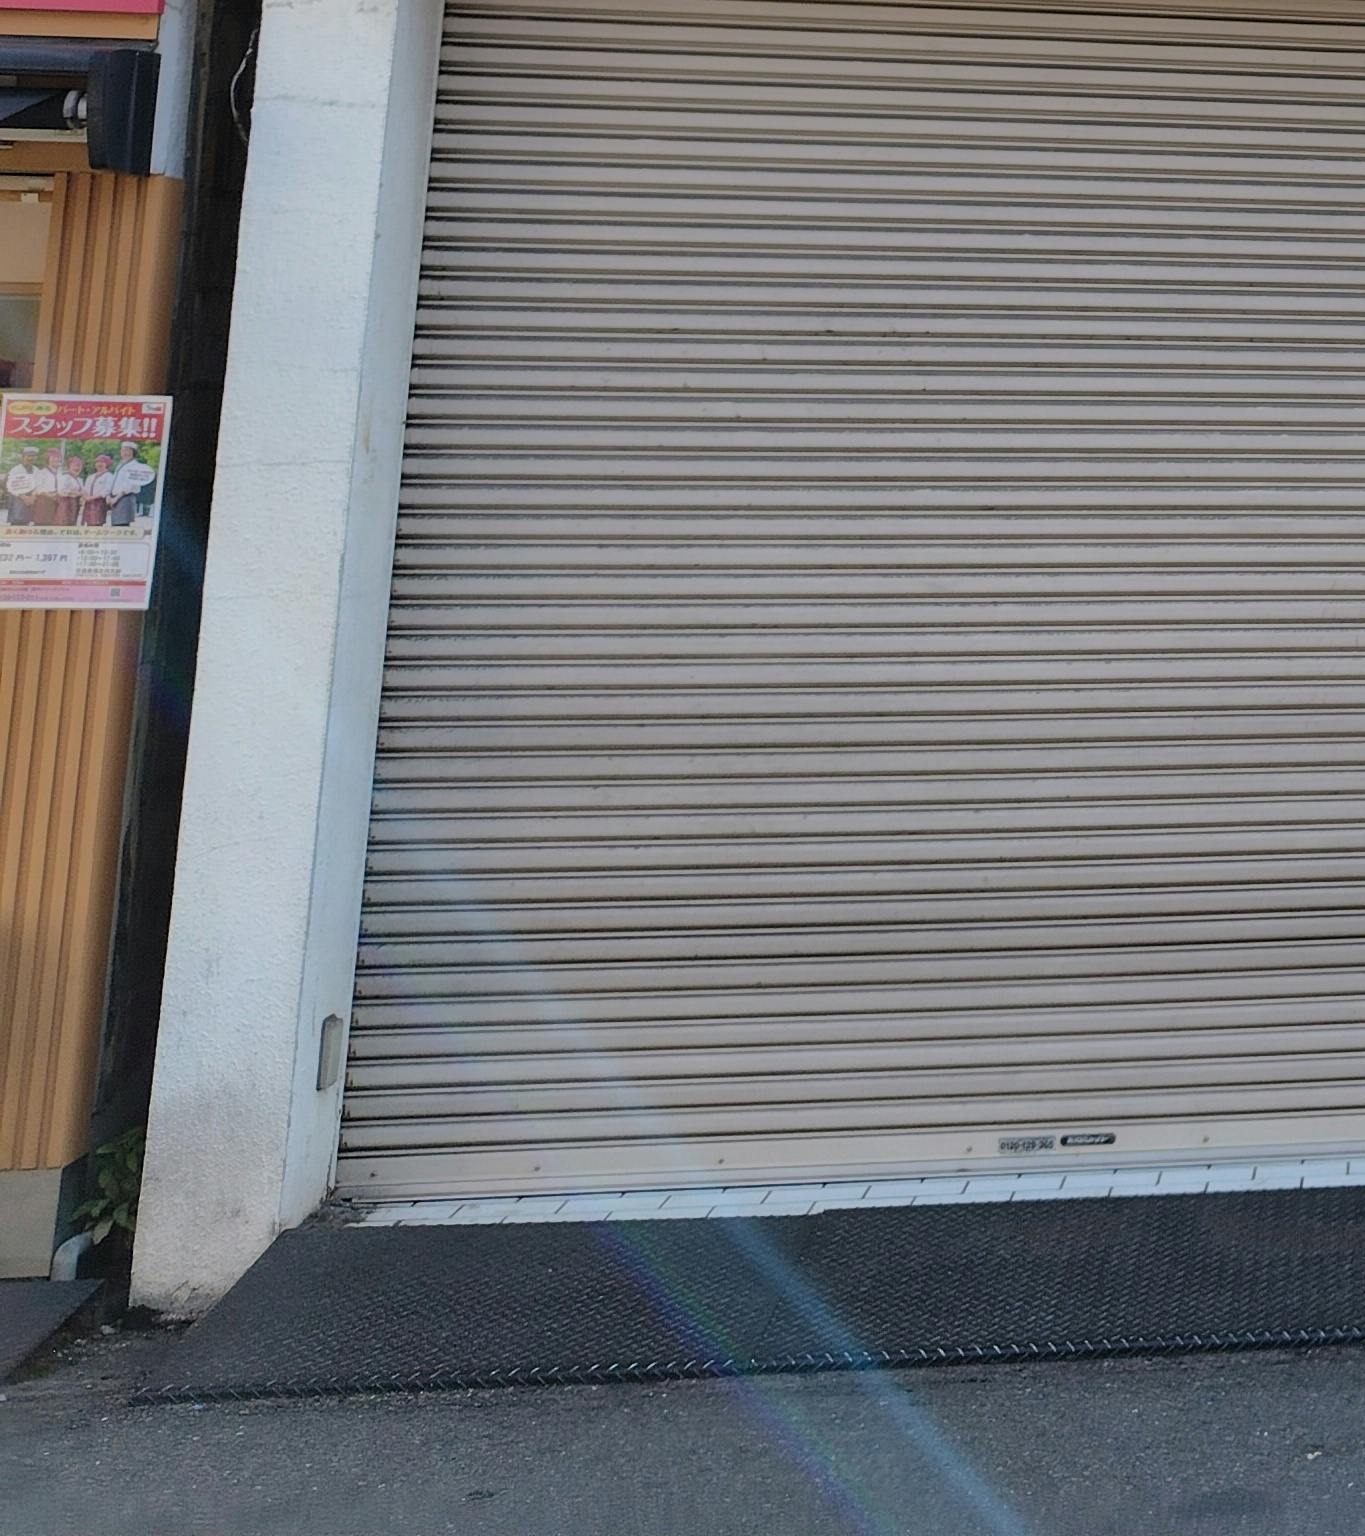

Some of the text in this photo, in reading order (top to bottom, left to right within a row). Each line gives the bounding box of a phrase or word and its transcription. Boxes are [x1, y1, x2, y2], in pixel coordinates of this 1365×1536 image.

[8, 415, 158, 439] スタッフ募集!!
